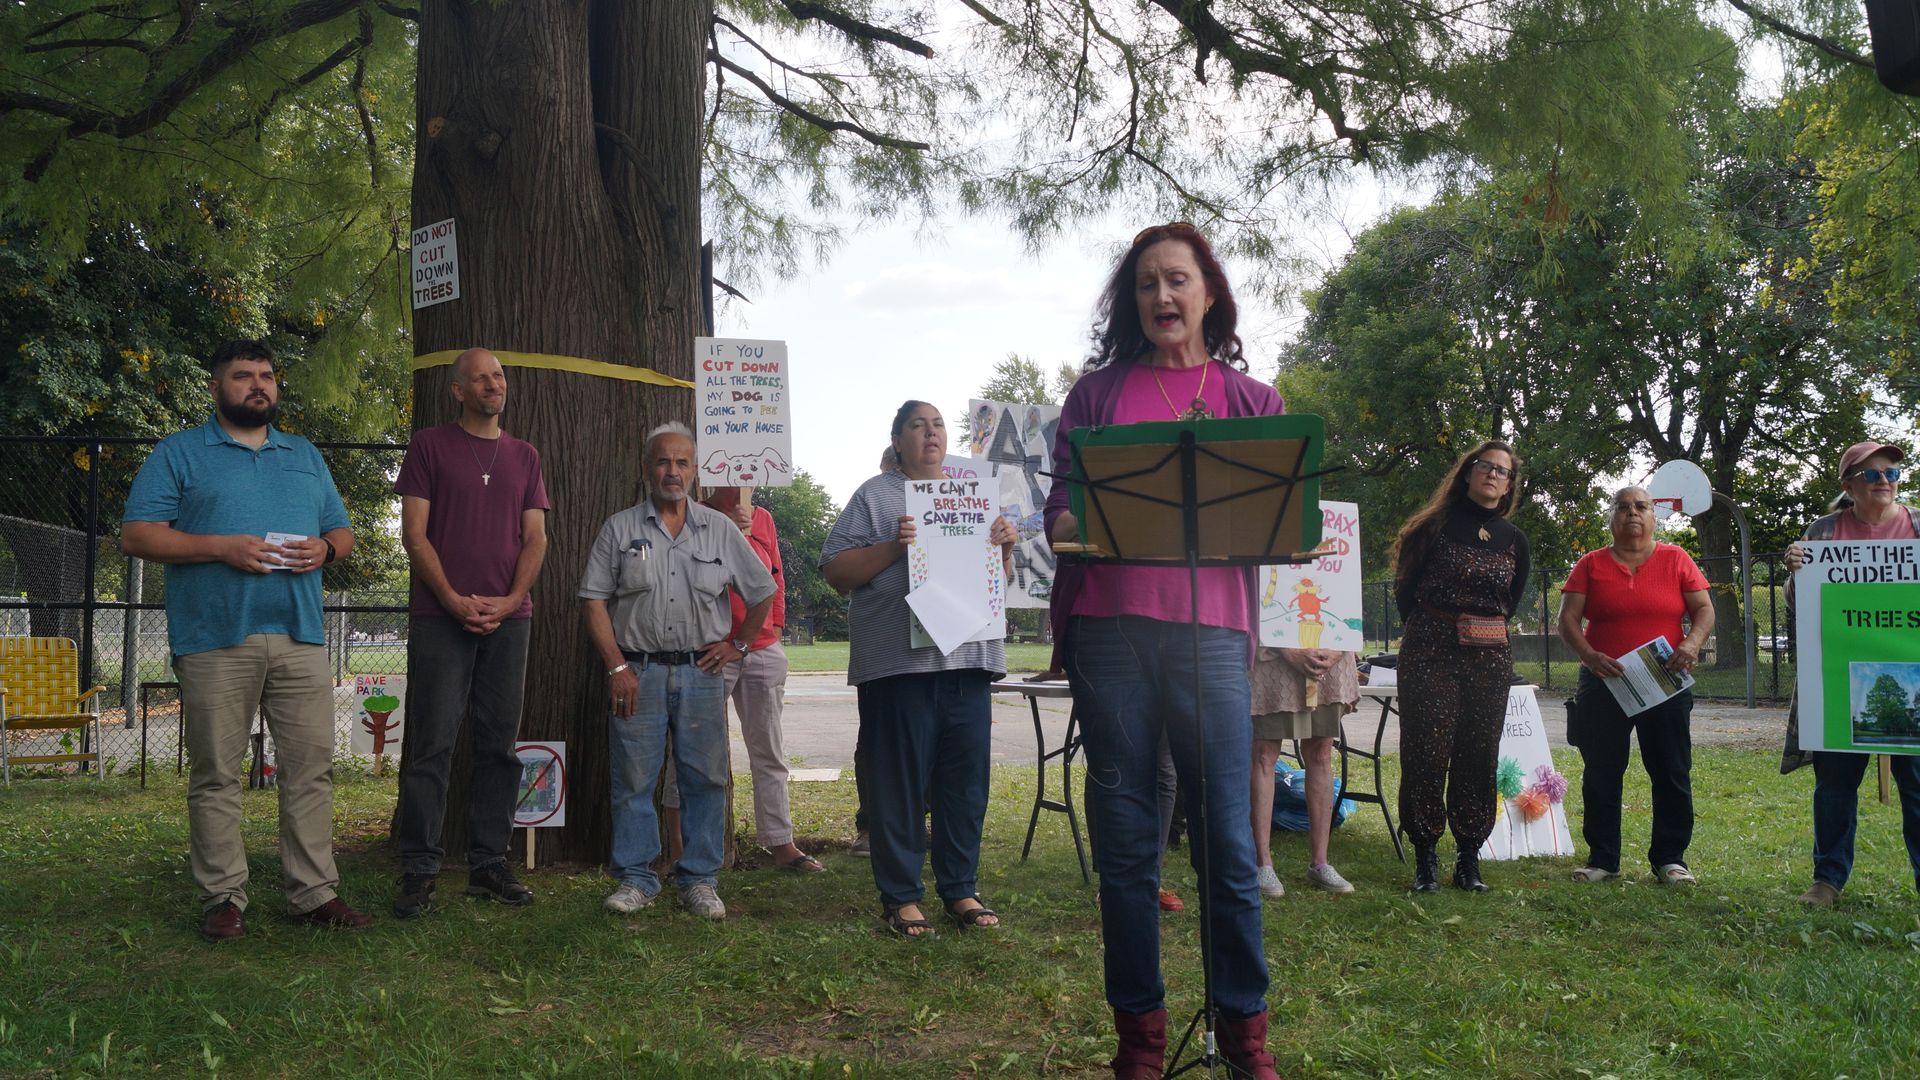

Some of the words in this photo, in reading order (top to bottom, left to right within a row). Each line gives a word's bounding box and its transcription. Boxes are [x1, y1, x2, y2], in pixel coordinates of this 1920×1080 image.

[414, 230, 429, 246] DO
[431, 221, 453, 240] NOT
[420, 244, 446, 264] CUT
[416, 261, 454, 283] DOWN
[415, 280, 453, 303] TREES
[710, 344, 724, 356] IF
[736, 344, 764, 358] YOU
[703, 359, 734, 372] CUT
[741, 362, 779, 373] DOWN
[706, 376, 726, 387] ALL
[730, 375, 748, 386] THE
[707, 391, 723, 402] MY
[731, 390, 763, 402] DOG
[770, 392, 781, 402] IS
[704, 406, 736, 417] GOING
[742, 405, 753, 414] TO
[705, 424, 719, 436] ON
[725, 420, 749, 435] YOUR
[755, 420, 784, 434] HOUSE
[913, 483, 934, 494] WE
[938, 480, 979, 497] CAN'T
[933, 496, 990, 511] BREATHE
[923, 510, 959, 526] SAVE
[959, 512, 986, 525] THE
[940, 525, 975, 537] TREES
[1802, 545, 1861, 565] SAVE
[1866, 545, 1914, 564] THE
[1316, 557, 1343, 574] YOU
[356, 676, 386, 686] SAVE
[356, 686, 385, 696] PARK
